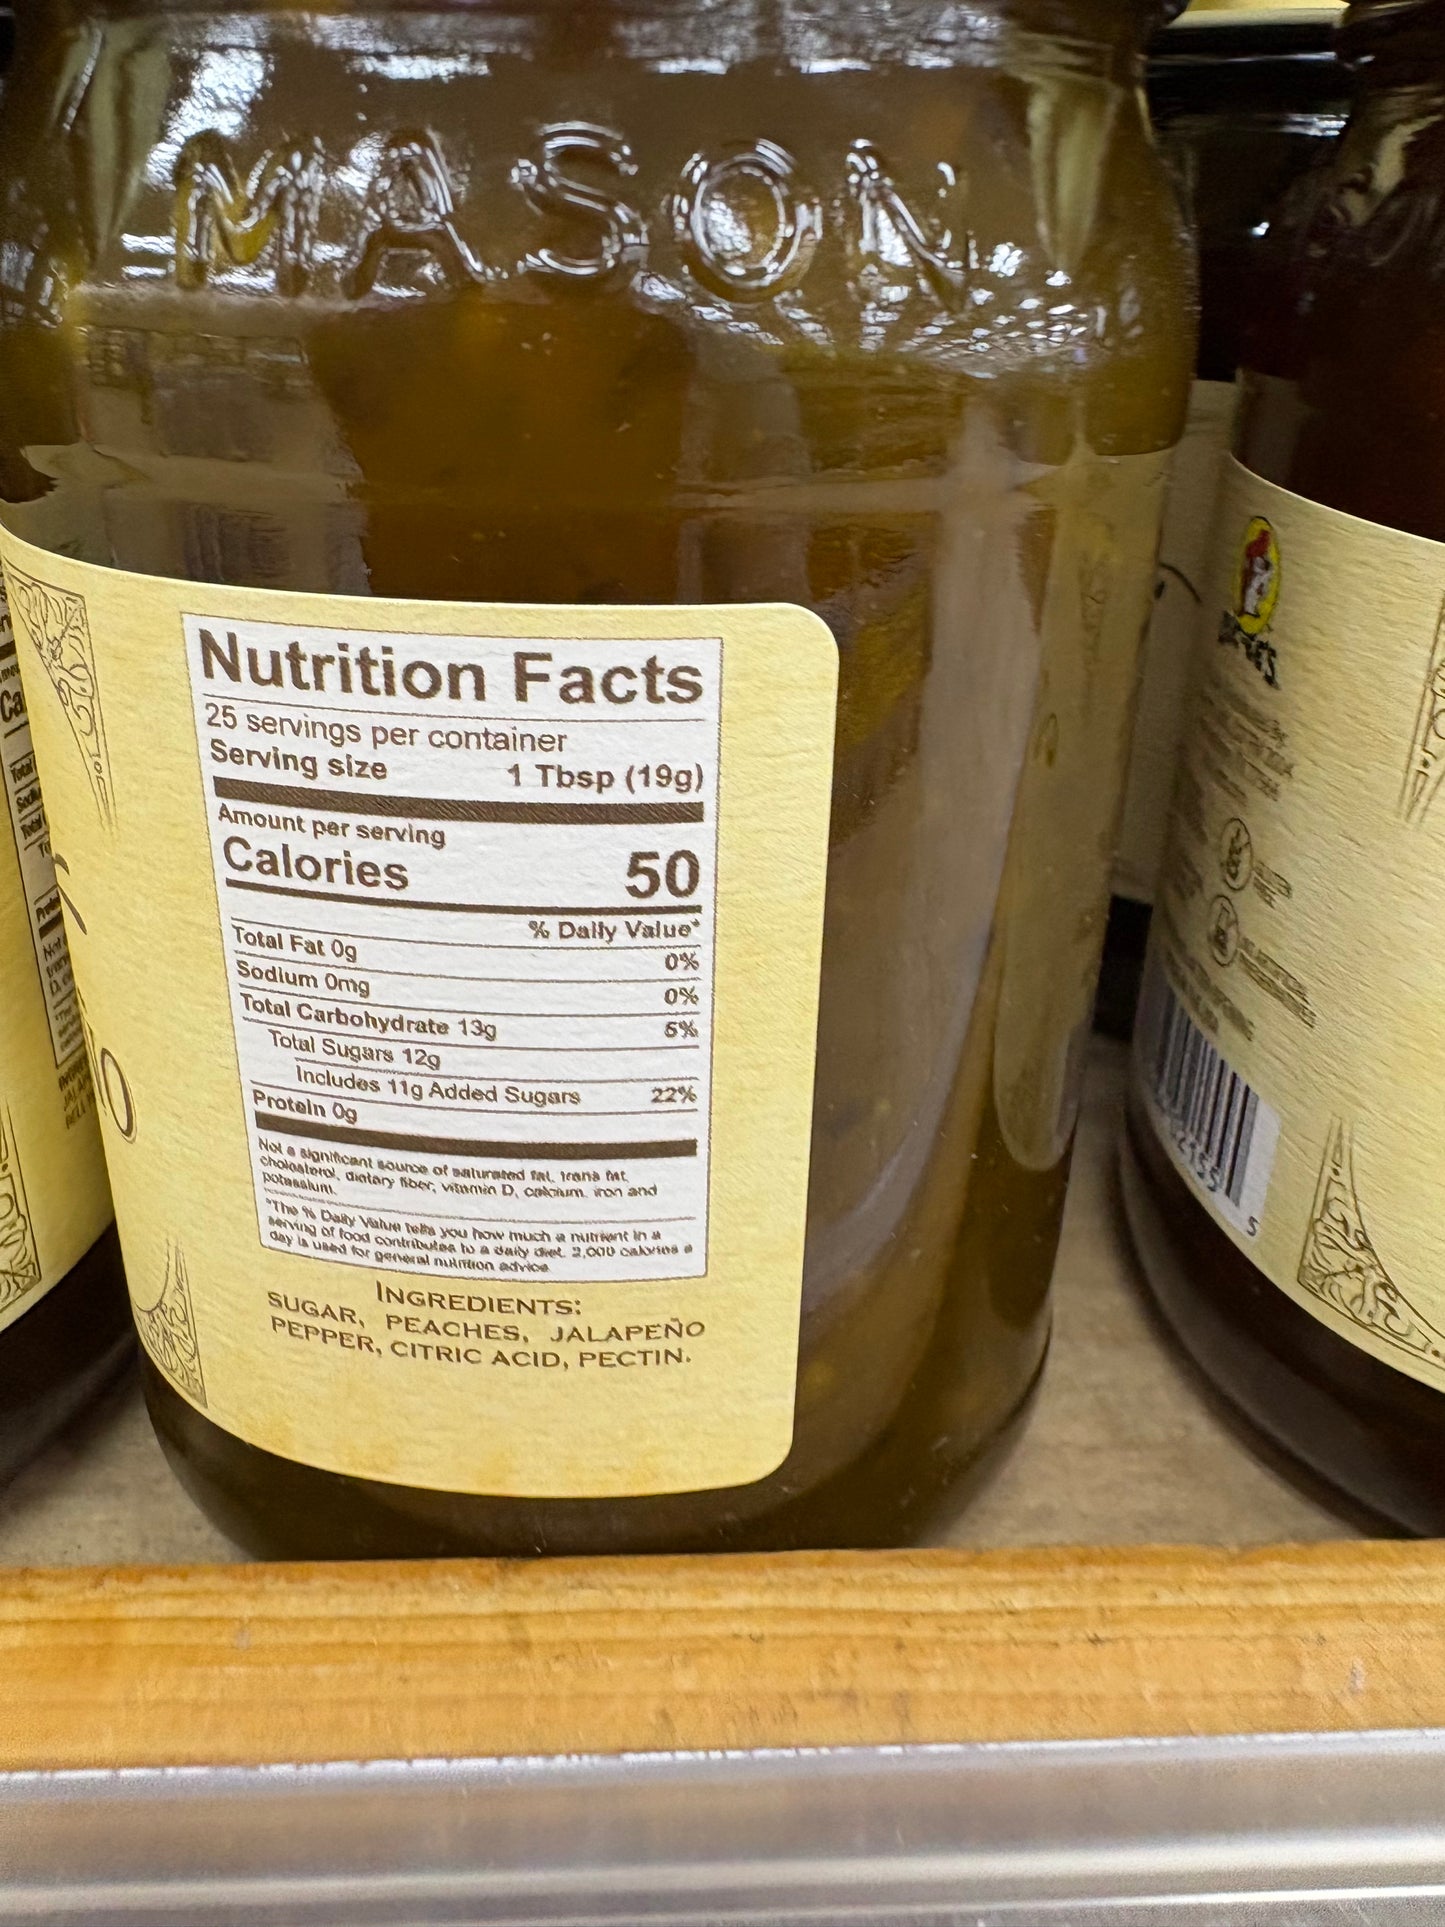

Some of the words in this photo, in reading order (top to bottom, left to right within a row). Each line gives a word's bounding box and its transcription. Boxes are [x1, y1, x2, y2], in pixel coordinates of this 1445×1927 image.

[167, 118, 968, 303] MASON
[199, 628, 485, 701] Nutrition
[515, 651, 703, 704] Facts
[205, 703, 237, 728] 25
[247, 711, 361, 746] servings
[373, 724, 417, 749] per
[428, 727, 566, 752] container
[210, 740, 318, 778] Serving
[329, 753, 387, 779] size
[507, 765, 521, 787] 1
[535, 764, 614, 793] Tbsp
[626, 764, 704, 796] (19g)
[218, 803, 305, 834] Amount
[313, 817, 349, 838] per
[356, 822, 446, 850] serving
[223, 837, 409, 891] Calories
[625, 850, 700, 898] 50
[232, 925, 284, 951] Total
[290, 933, 326, 957] Fat
[332, 939, 358, 963] 0g
[664, 952, 700, 971] 0%
[528, 921, 550, 938] %
[558, 921, 616, 944] Daily
[237, 960, 318, 990] Sodium
[326, 973, 370, 997] 0mg
[664, 987, 699, 1005] 0%
[241, 992, 291, 1019] Total
[297, 1003, 449, 1036] Carbohydrate
[457, 1019, 497, 1040] 13g
[268, 1028, 316, 1053] Total
[322, 1038, 394, 1065] Sugars
[402, 1047, 440, 1070] 12g
[253, 1089, 326, 1118] Protein
[332, 1100, 358, 1124] 0g
[296, 1066, 381, 1094] Includes
[387, 1079, 423, 1101] 11g
[429, 1081, 498, 1103] Added
[504, 1086, 581, 1107] Sugars
[651, 1086, 696, 1105] 22%
[259, 1137, 282, 1153] Not
[287, 1145, 296, 1155] a
[300, 1147, 373, 1168] significant
[377, 1160, 428, 1174] source
[433, 1165, 448, 1176] of
[452, 1167, 525, 1183] saturated
[561, 1170, 600, 1182] trans
[263, 1172, 337, 1195] potassium.
[346, 1171, 395, 1189] dietary
[400, 1177, 437, 1193] fiber,
[442, 1182, 496, 1196] vitamin
[502, 1184, 518, 1199] D,
[594, 1186, 622, 1197] iron
[627, 1185, 657, 1196] and
[269, 1216, 316, 1237] serving
[322, 1226, 335, 1238] of
[339, 1229, 369, 1243] food
[375, 1235, 456, 1254] contributes
[461, 1243, 475, 1254] to
[495, 1245, 529, 1258] daily
[572, 1247, 615, 1259] 2,000
[620, 1244, 679, 1256] calories
[321, 1209, 356, 1227] Daily
[360, 1215, 401, 1232] Value
[405, 1221, 436, 1236] tells
[440, 1227, 468, 1240] you
[472, 1228, 504, 1240] how
[509, 1229, 550, 1242] much
[571, 1230, 629, 1242] nutrient
[633, 1230, 647, 1240] in
[270, 1230, 293, 1248] day
[298, 1236, 309, 1248] is
[313, 1240, 347, 1255] used
[352, 1245, 369, 1258] for
[375, 1250, 430, 1265] general
[434, 1258, 494, 1271] nutrition
[267, 1290, 365, 1328] SUGAR,
[386, 1312, 529, 1343] PEACHES,
[551, 1317, 705, 1343] JALAPEÑO
[376, 1281, 582, 1316] INGREDIENTS:
[271, 1316, 383, 1357] PEPPER,
[391, 1341, 483, 1366] CITRIC
[491, 1349, 569, 1370] ACID,
[579, 1347, 692, 1369] PECTIN.
